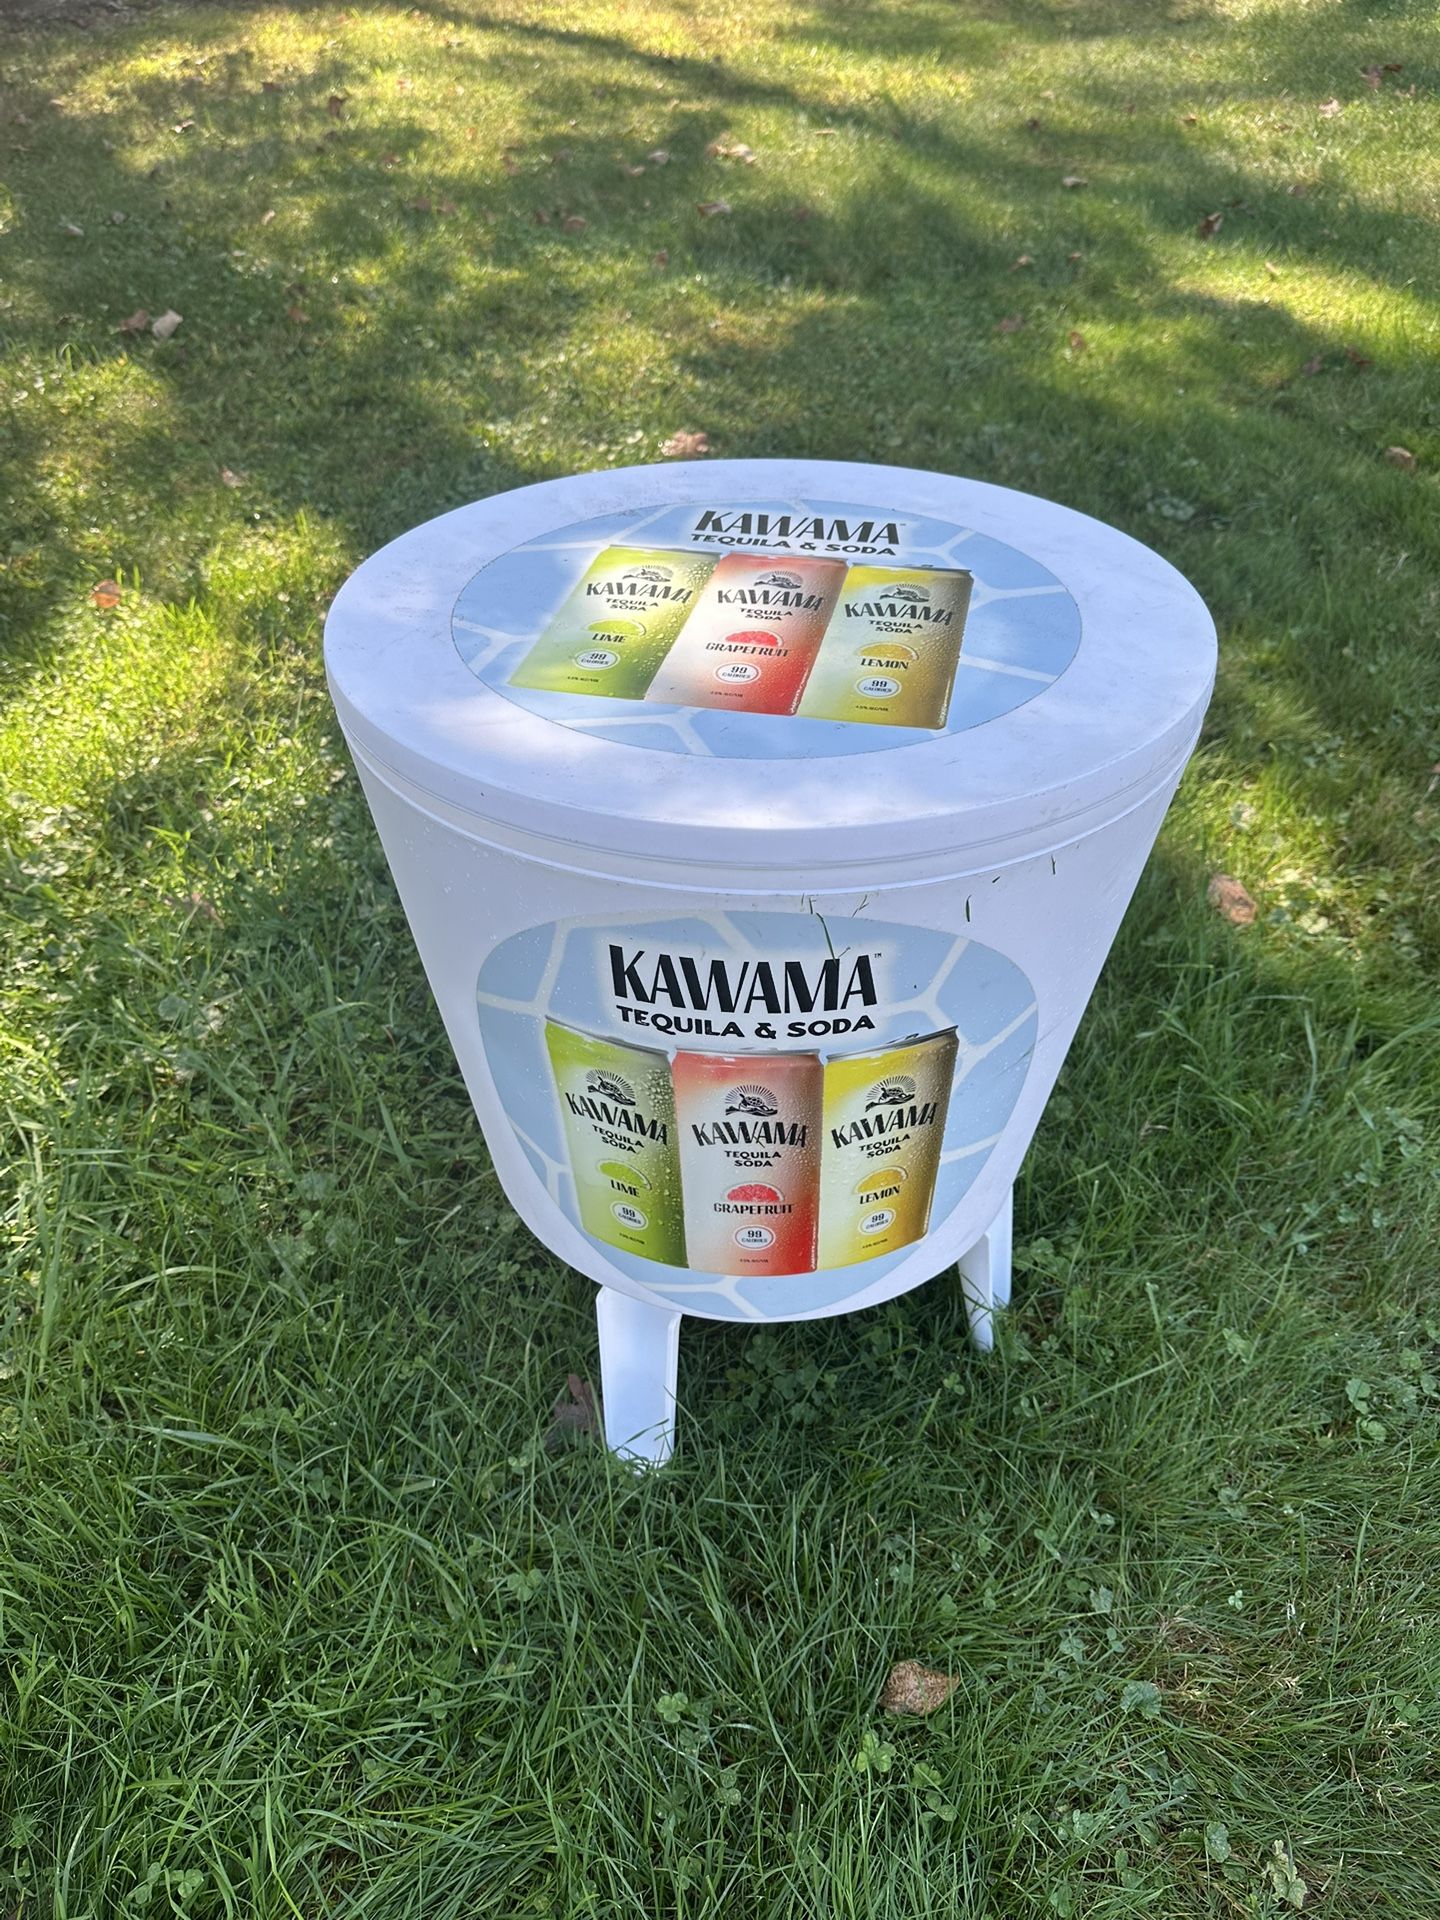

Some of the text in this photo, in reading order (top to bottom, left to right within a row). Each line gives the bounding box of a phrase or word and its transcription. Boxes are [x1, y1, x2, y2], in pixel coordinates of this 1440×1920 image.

[695, 510, 900, 545] KAWAMA
[691, 533, 896, 556] TEQUILA & SODA
[586, 582, 693, 604] KAWAMA
[717, 588, 825, 611] KAWAMA
[605, 598, 659, 607] TEQUILA
[740, 607, 793, 616] TEQUILA
[844, 602, 954, 626] KAWAMA
[868, 619, 923, 629] TEQUILA
[875, 626, 913, 634] SODA
[592, 633, 628, 643] LIME
[705, 642, 789, 657] GRAPEFRUIT
[731, 666, 748, 674] 99
[860, 658, 910, 670] LEMON
[871, 680, 888, 688] 99
[609, 944, 878, 1014] KAWAMA
[616, 1004, 876, 1039] TEQUILA & SODA
[565, 1092, 668, 1146] KAWAMA
[831, 1102, 938, 1150] KAWAMA
[591, 1123, 645, 1148] TEQUILA
[691, 1120, 809, 1148] KAWAMA
[859, 1133, 911, 1152] TEQUILA
[601, 1135, 637, 1154] SODA
[866, 1144, 902, 1159] SODA
[724, 1150, 782, 1159] TEQUILA
[610, 1179, 640, 1198] LIME
[859, 1185, 901, 1205] LEMON
[622, 1207, 636, 1217] 99
[713, 1203, 794, 1215] GRAPEFRUIT
[871, 1213, 885, 1222] 99
[747, 1230, 762, 1238] 99
